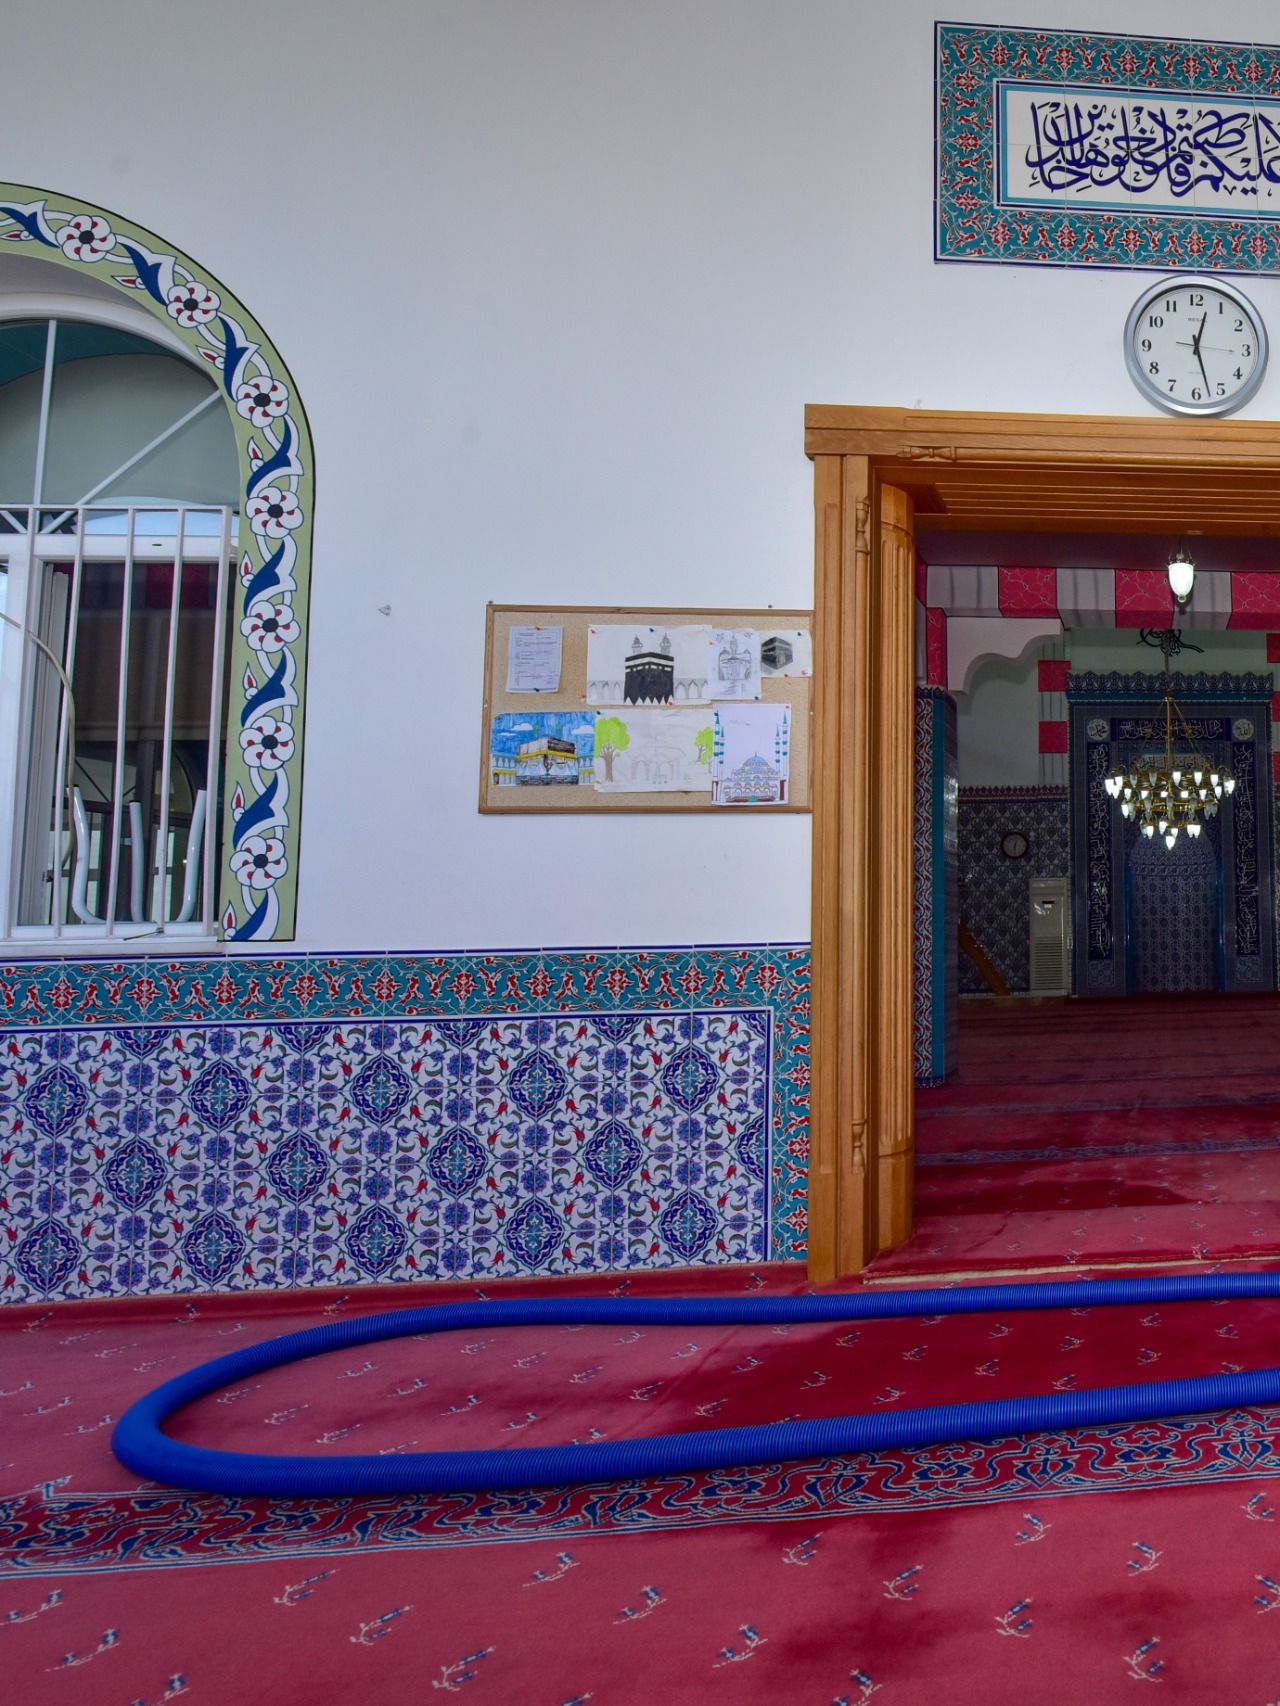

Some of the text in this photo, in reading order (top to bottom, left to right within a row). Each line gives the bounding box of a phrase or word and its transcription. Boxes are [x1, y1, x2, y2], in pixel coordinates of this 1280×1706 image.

[1166, 300, 1177, 312] 11
[1189, 294, 1204, 306] 12
[1219, 302, 1223, 314] 1
[1149, 315, 1164, 328] 10
[1234, 319, 1243, 332] 2
[1141, 339, 1152, 352] 9
[1241, 344, 1251, 357] 3
[1149, 361, 1159, 374] 8
[1233, 366, 1243, 380] 4
[1167, 379, 1177, 392] 7
[1216, 383, 1226, 396] 5
[1191, 387, 1202, 401] 6
